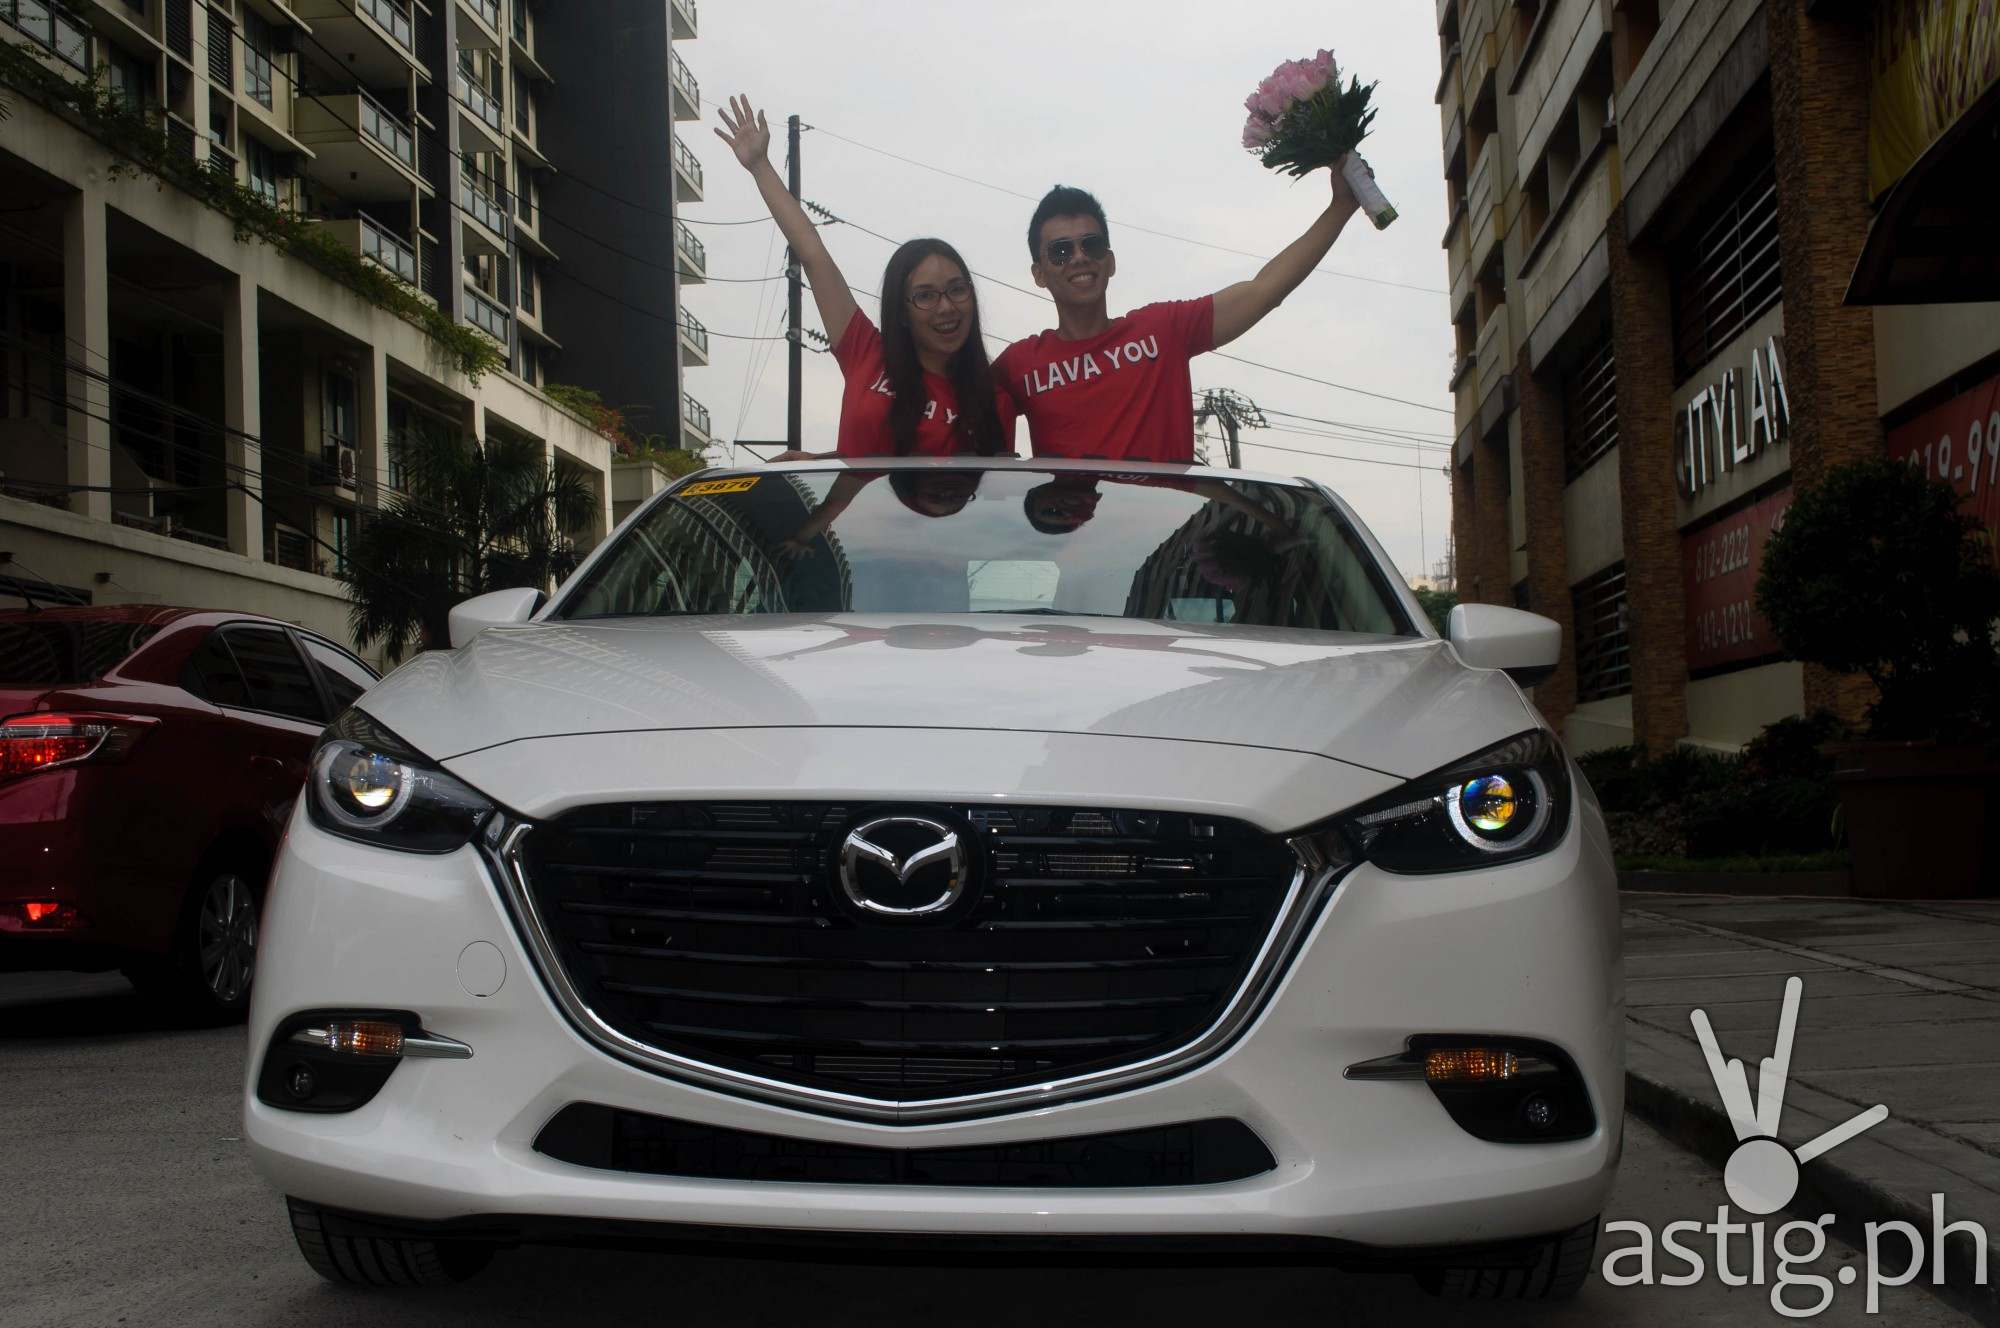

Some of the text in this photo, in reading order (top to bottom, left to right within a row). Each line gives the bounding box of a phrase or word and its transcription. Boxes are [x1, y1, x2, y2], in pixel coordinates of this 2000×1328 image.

[1023, 335, 1159, 397] I LAVA YOU
[1695, 524, 1750, 584] 812-2222
